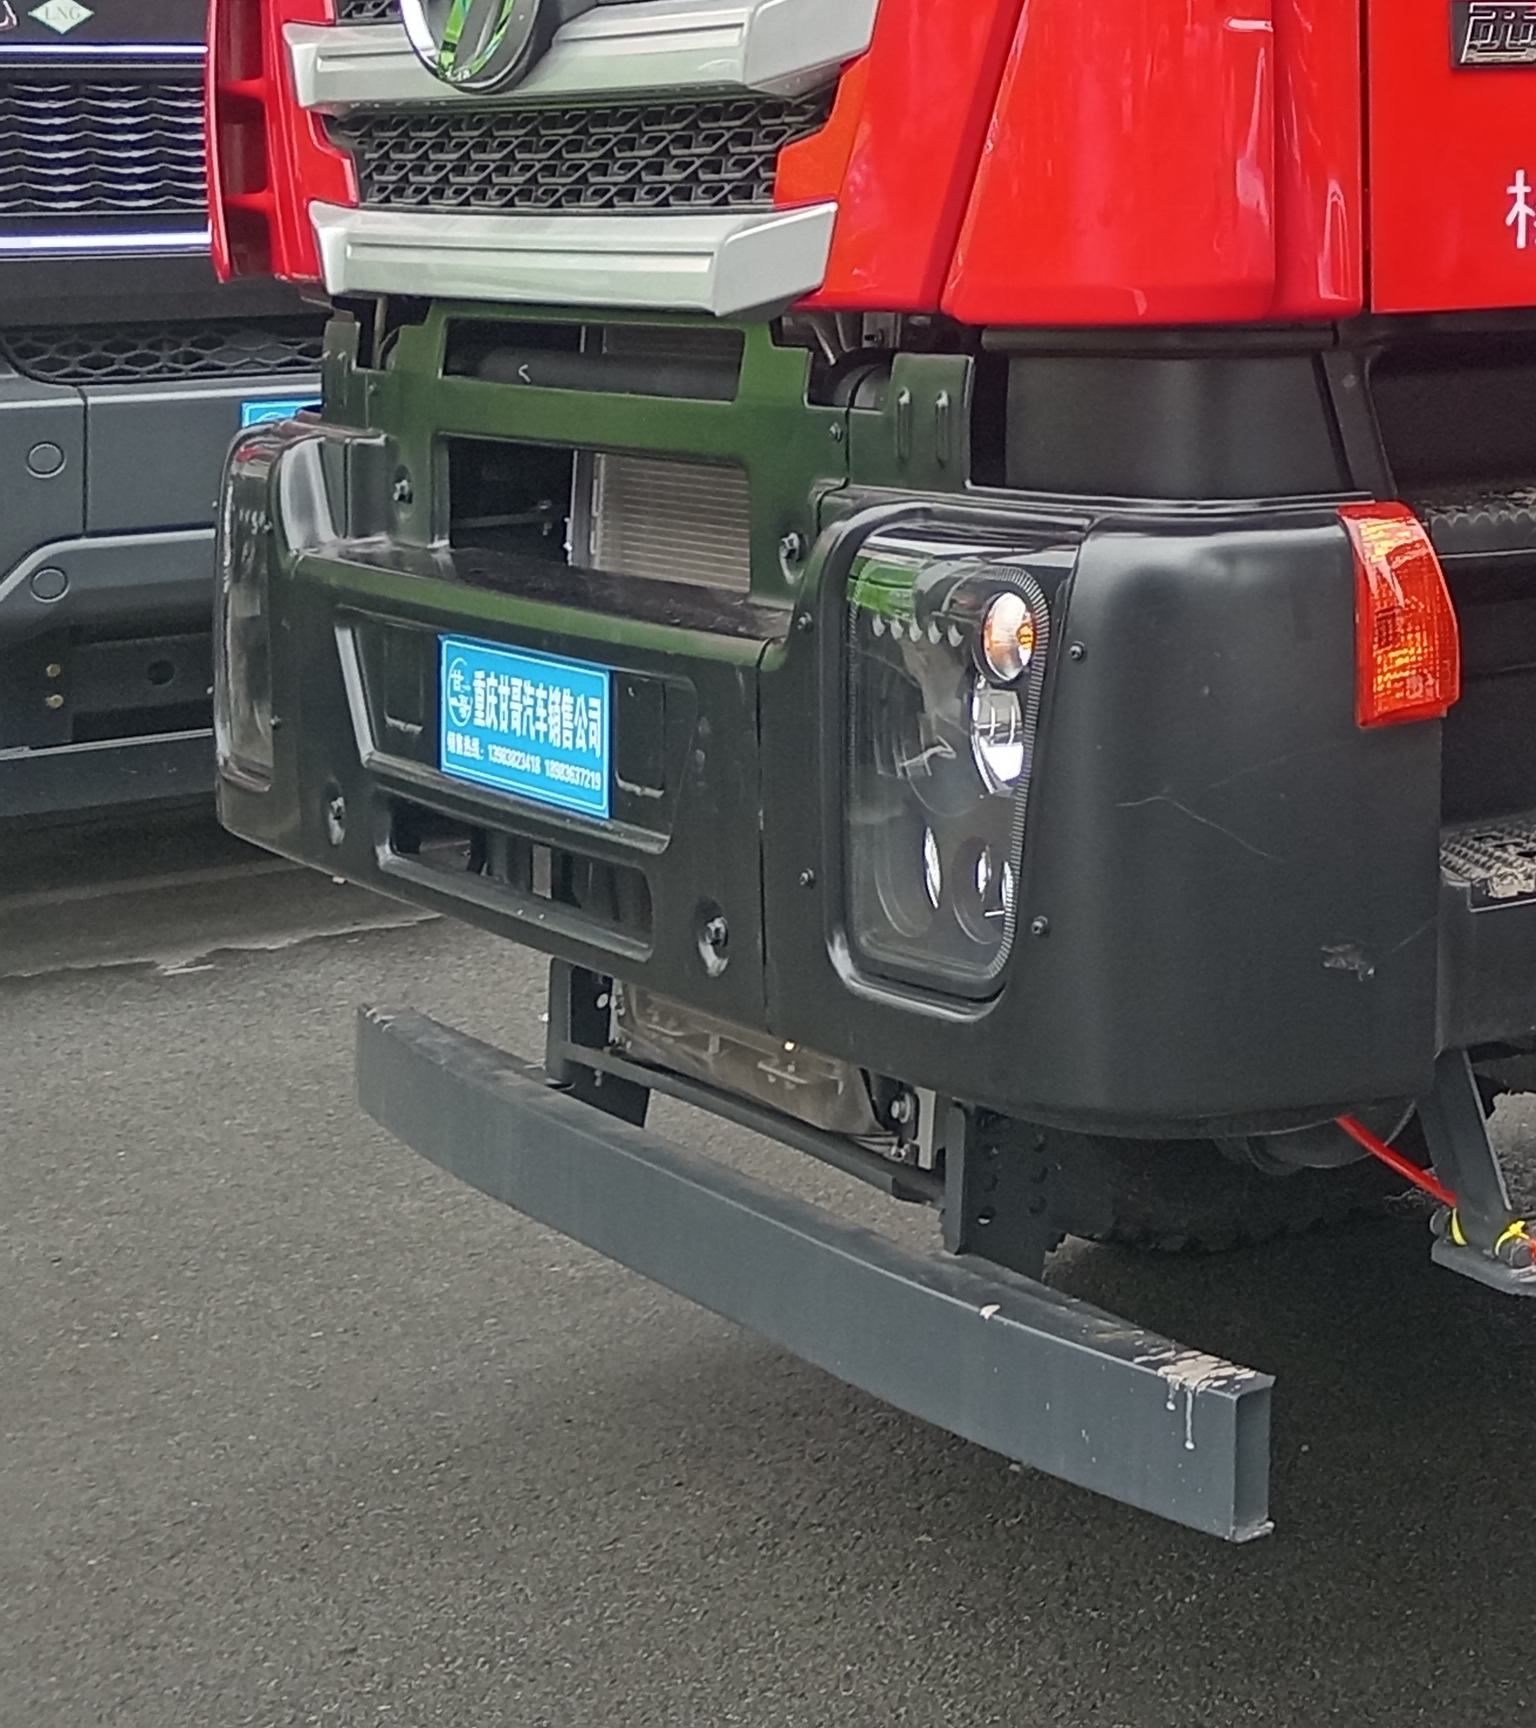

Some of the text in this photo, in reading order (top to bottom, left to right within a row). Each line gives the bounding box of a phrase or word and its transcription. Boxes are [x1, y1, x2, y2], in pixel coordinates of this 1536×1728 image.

[44, 5, 82, 22] LNG
[472, 669, 603, 759] 重庆甘哥汽车销售公司
